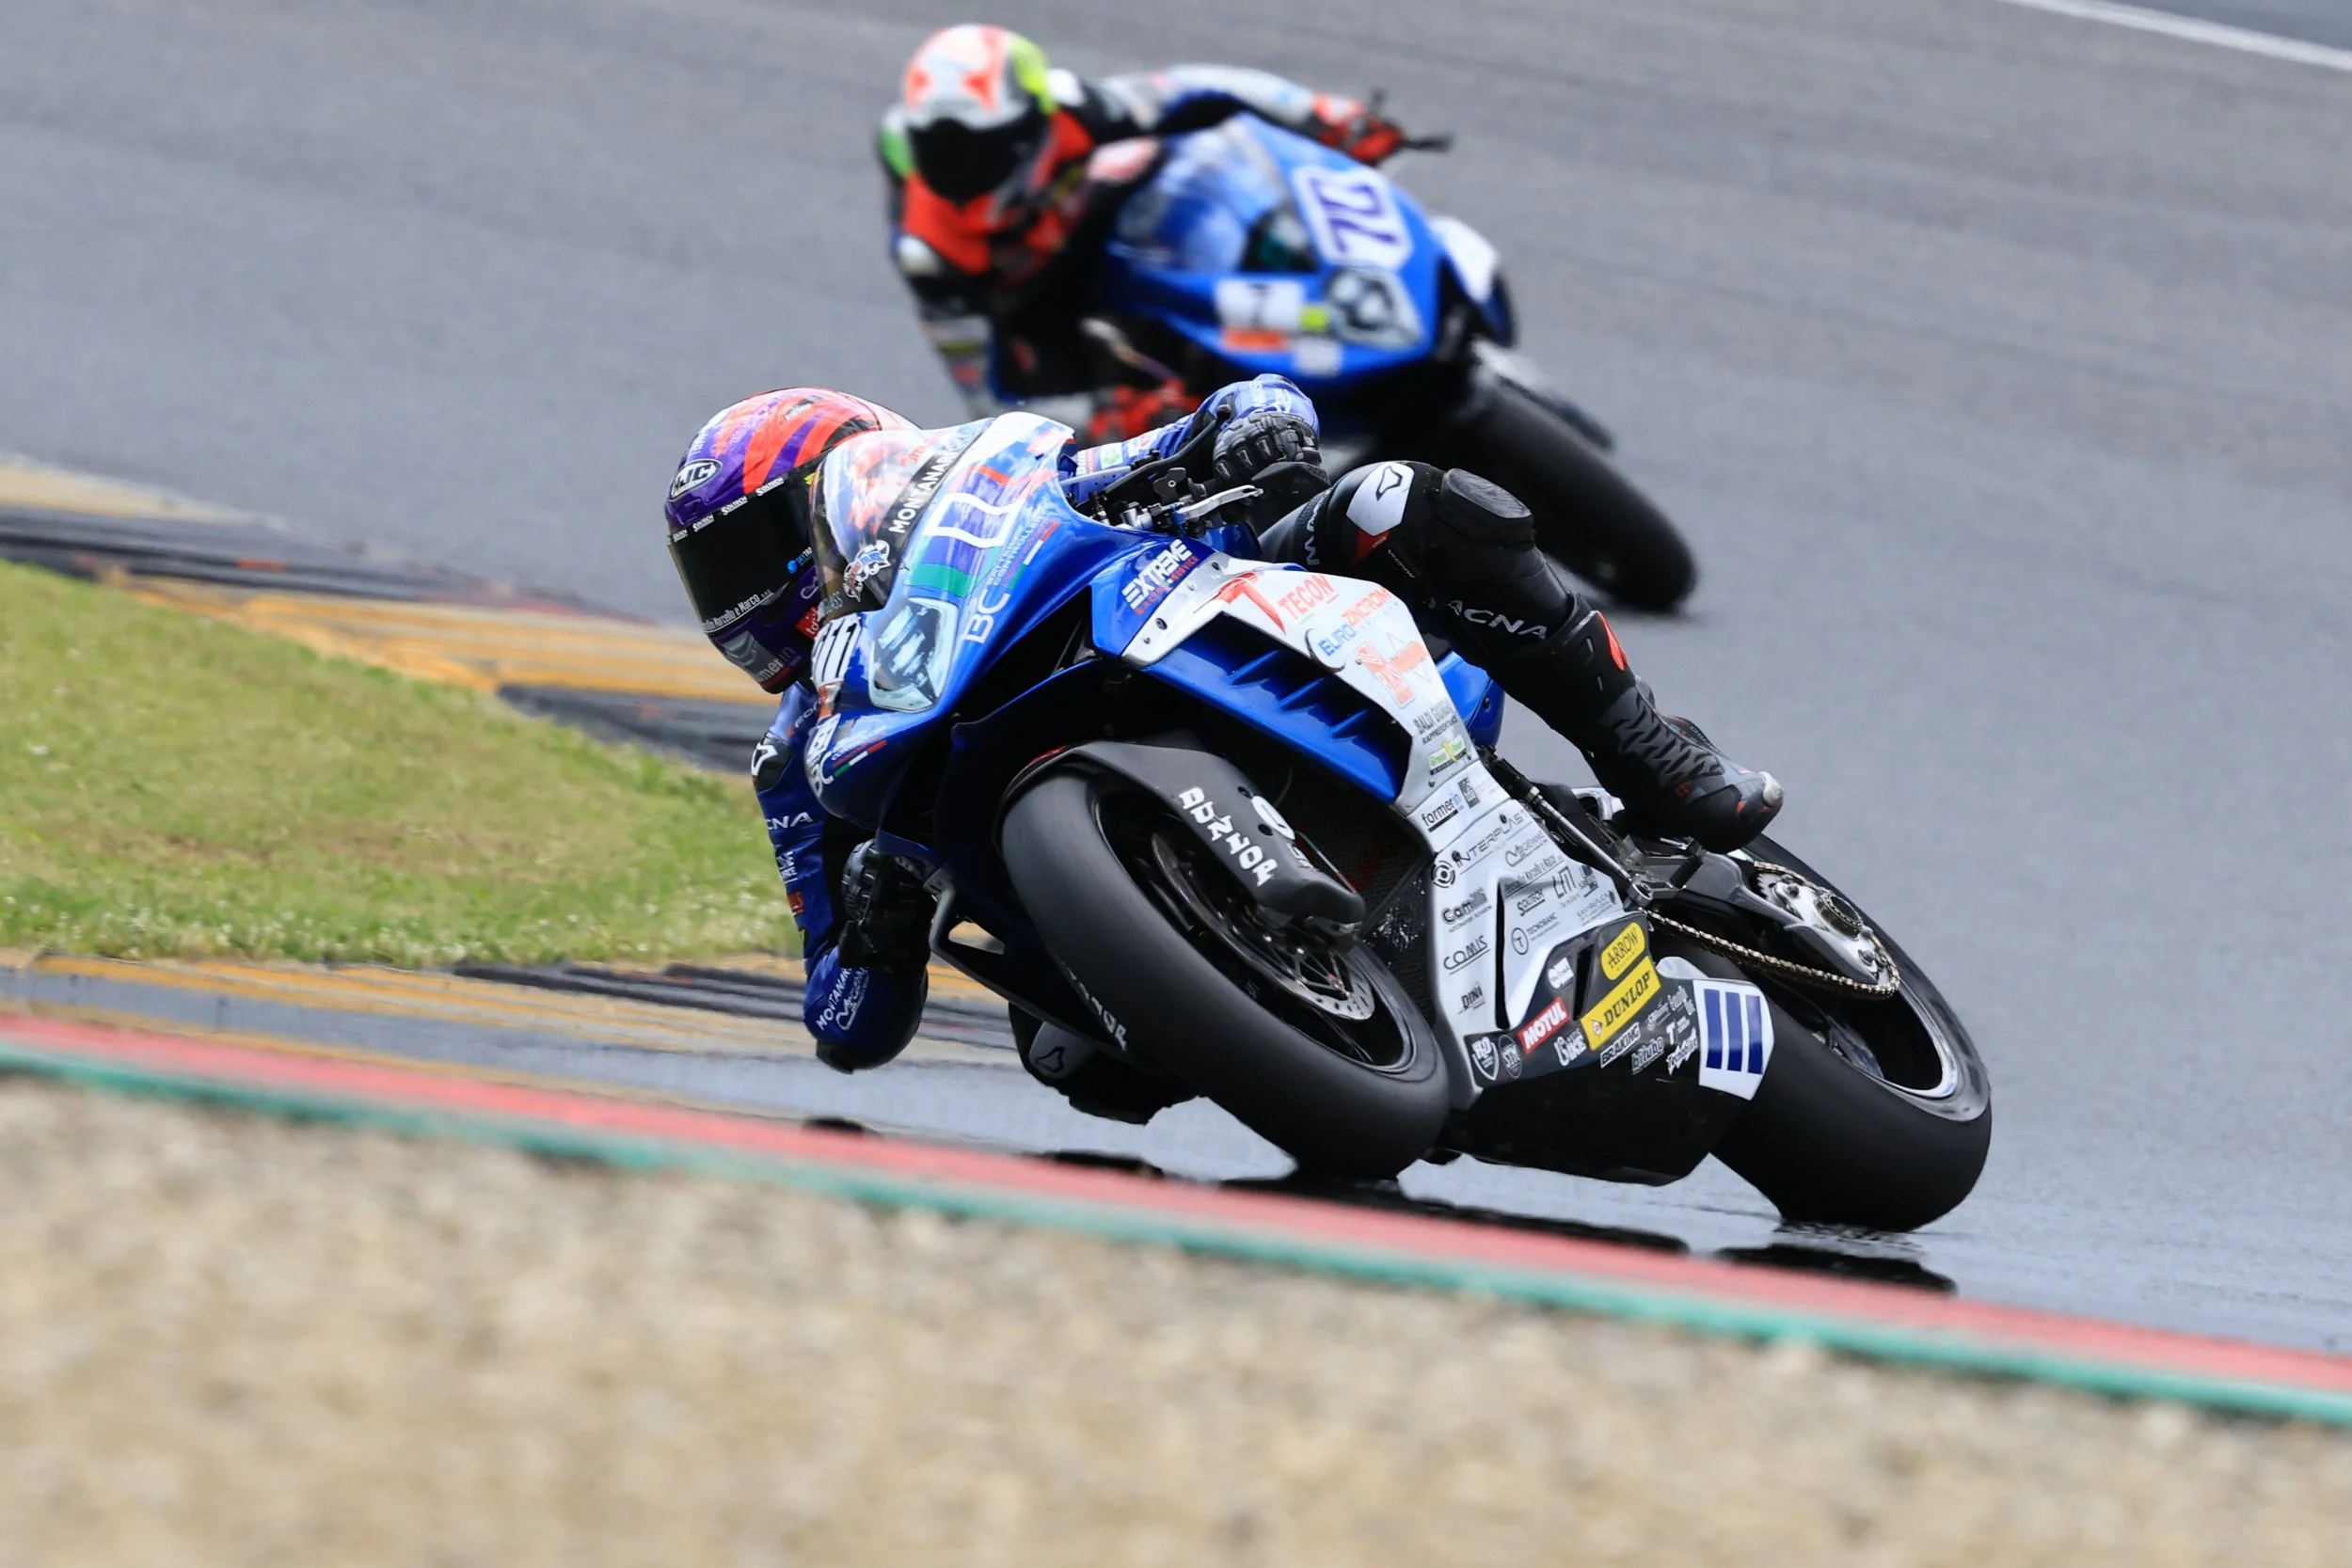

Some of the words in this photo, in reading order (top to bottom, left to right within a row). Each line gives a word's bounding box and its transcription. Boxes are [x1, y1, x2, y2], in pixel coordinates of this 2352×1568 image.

[1445, 599, 1548, 640] ACNA
[1177, 786, 1279, 887] DUNLOP
[1605, 971, 1651, 1027] DUNLOP
[1523, 1002, 1568, 1051] MOTUL
